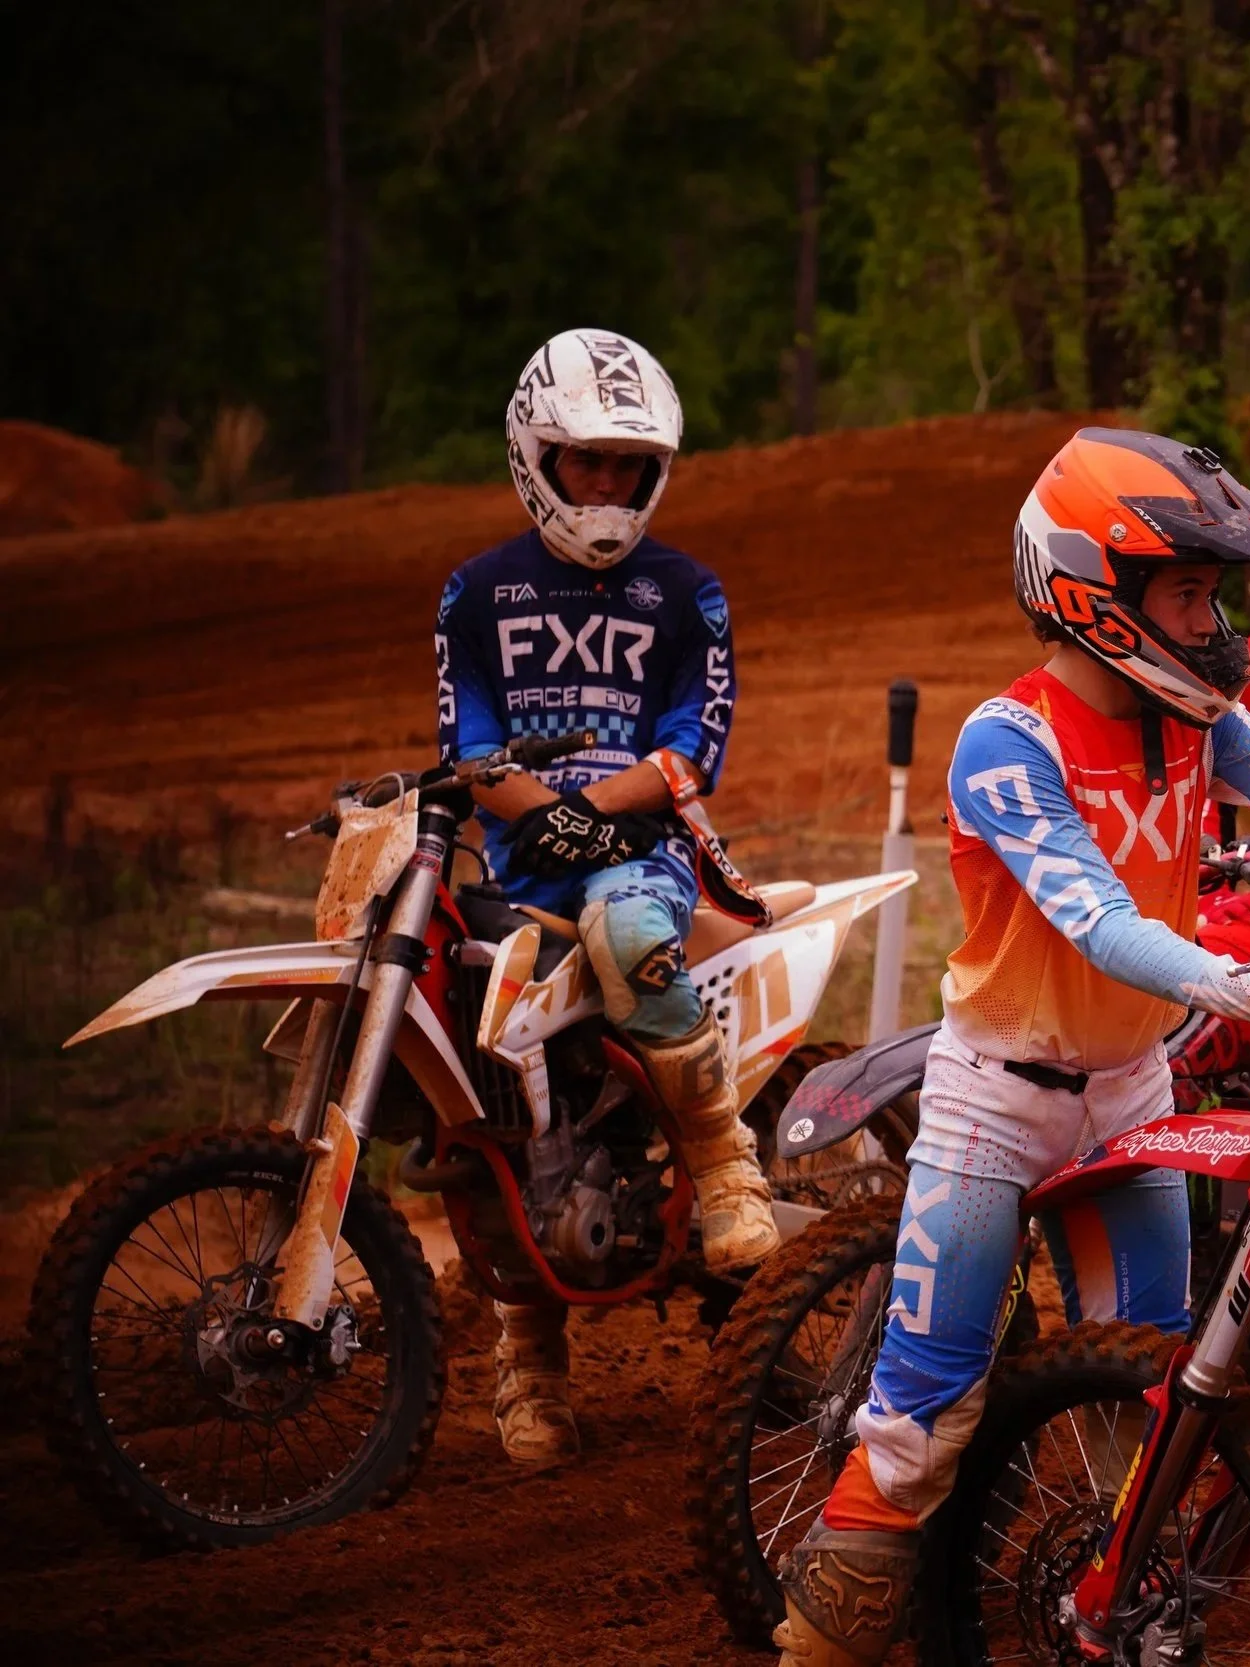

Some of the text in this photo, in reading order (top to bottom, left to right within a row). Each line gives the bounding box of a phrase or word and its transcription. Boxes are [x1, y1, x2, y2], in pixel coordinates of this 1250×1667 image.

[494, 582, 538, 604] FTA
[497, 614, 655, 682] FXR
[507, 686, 579, 711] RACE
[979, 702, 1042, 732] FXR
[537, 832, 581, 862] FOX
[967, 764, 1100, 939] FXR
[638, 943, 679, 988] FX
